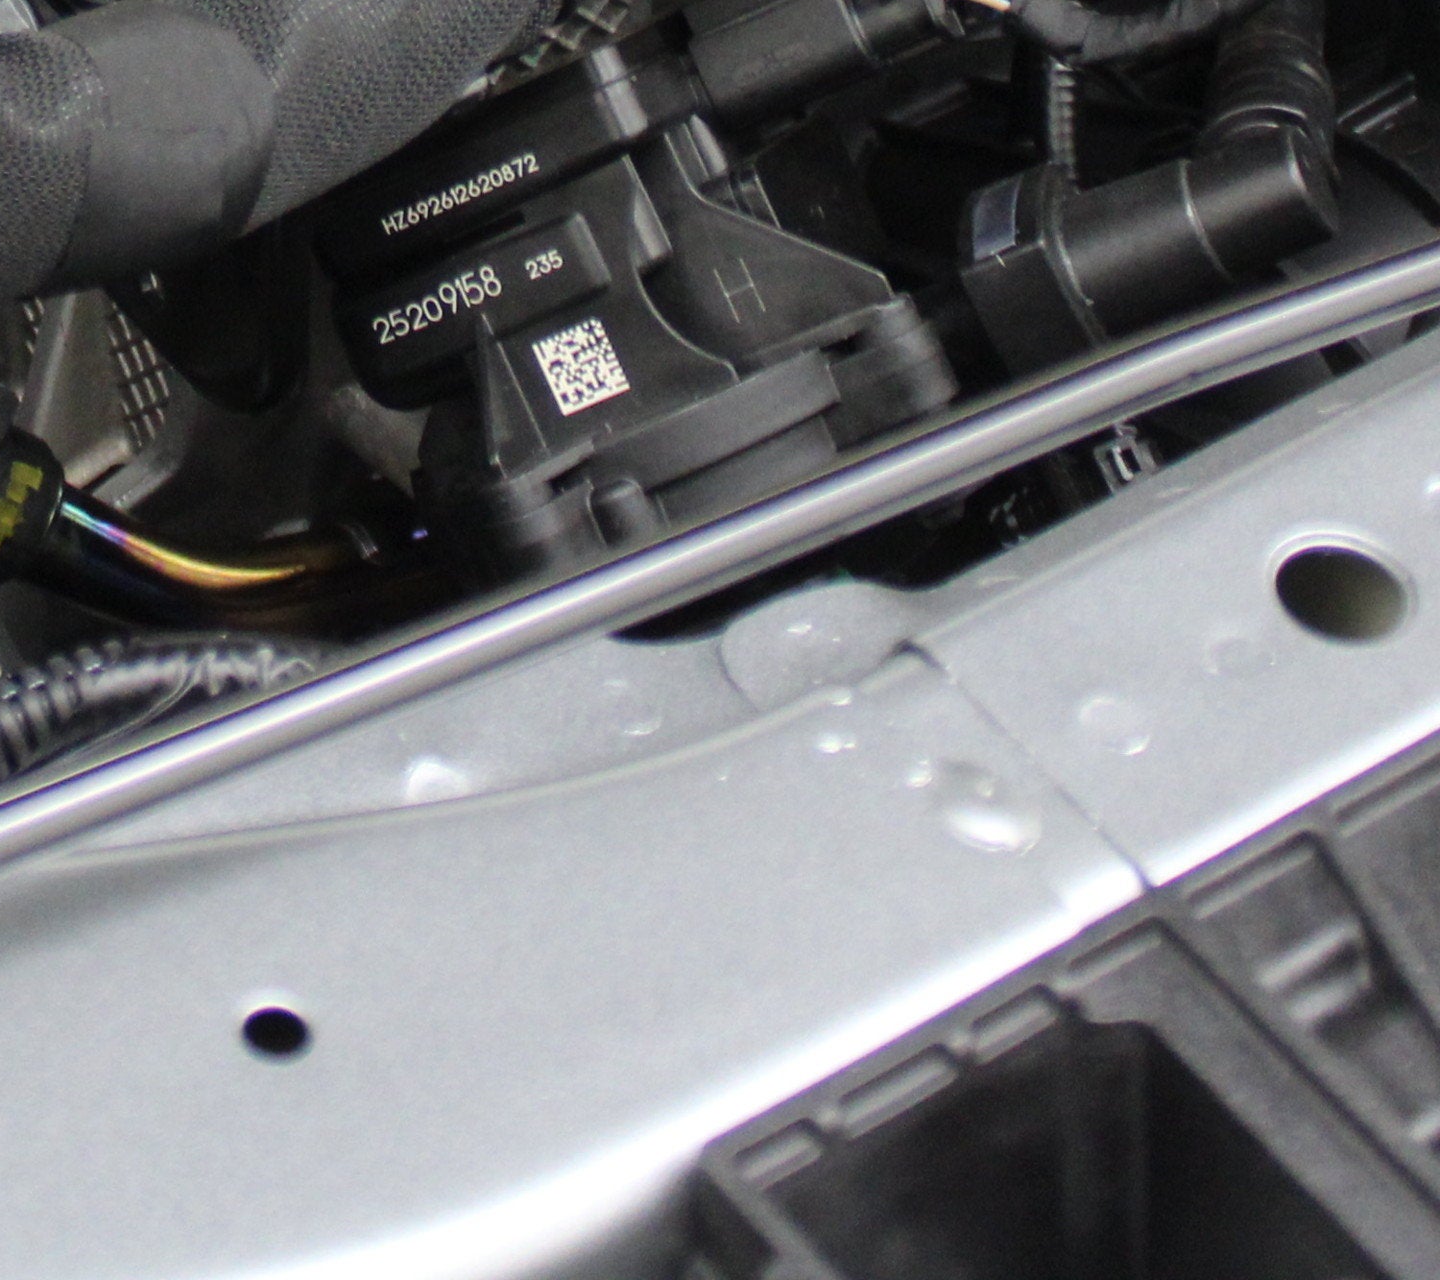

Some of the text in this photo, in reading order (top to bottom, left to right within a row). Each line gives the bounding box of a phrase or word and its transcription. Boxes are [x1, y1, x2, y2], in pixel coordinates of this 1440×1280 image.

[380, 151, 540, 236] HZ692612620872
[372, 248, 564, 344] 25209158 235
